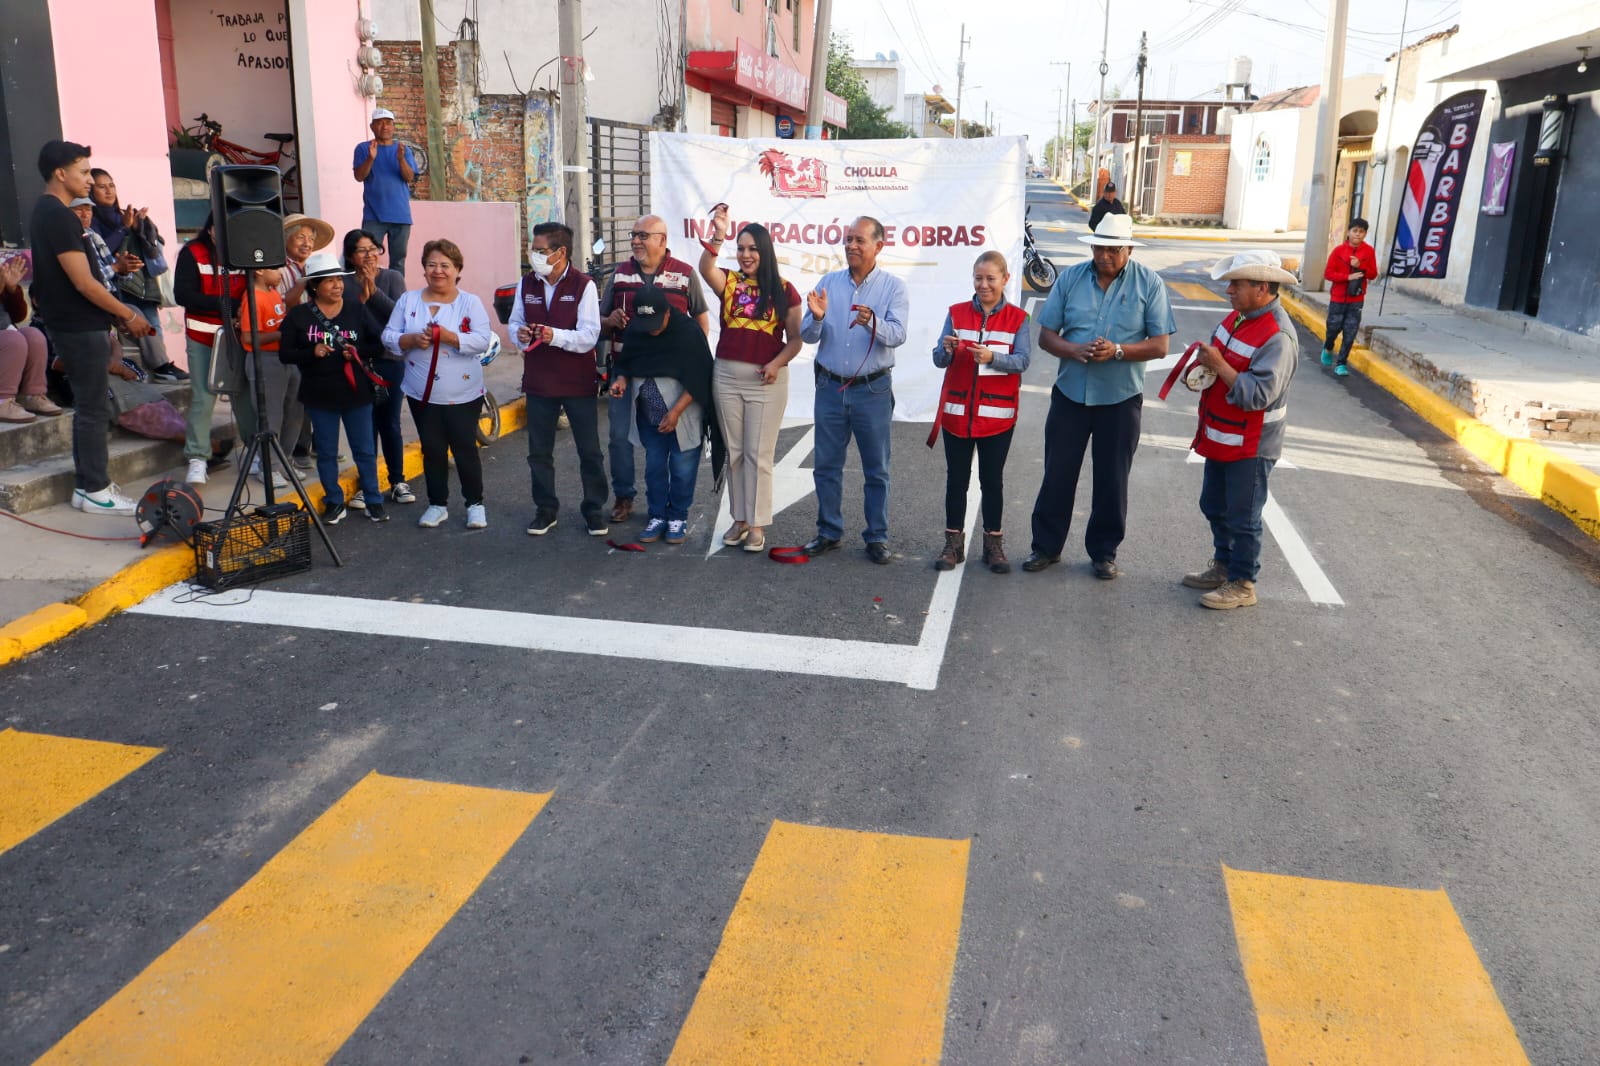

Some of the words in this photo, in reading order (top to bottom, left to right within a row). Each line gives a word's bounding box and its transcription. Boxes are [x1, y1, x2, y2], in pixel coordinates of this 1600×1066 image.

[216, 12, 265, 27] TRABAJA
[243, 31, 257, 43] LO
[265, 28, 288, 42] QUE
[844, 166, 898, 178] CHOLULA
[1419, 123, 1470, 275] BARBER
[683, 217, 850, 245] INAURACIÓ
[901, 225, 986, 247] OBRAS
